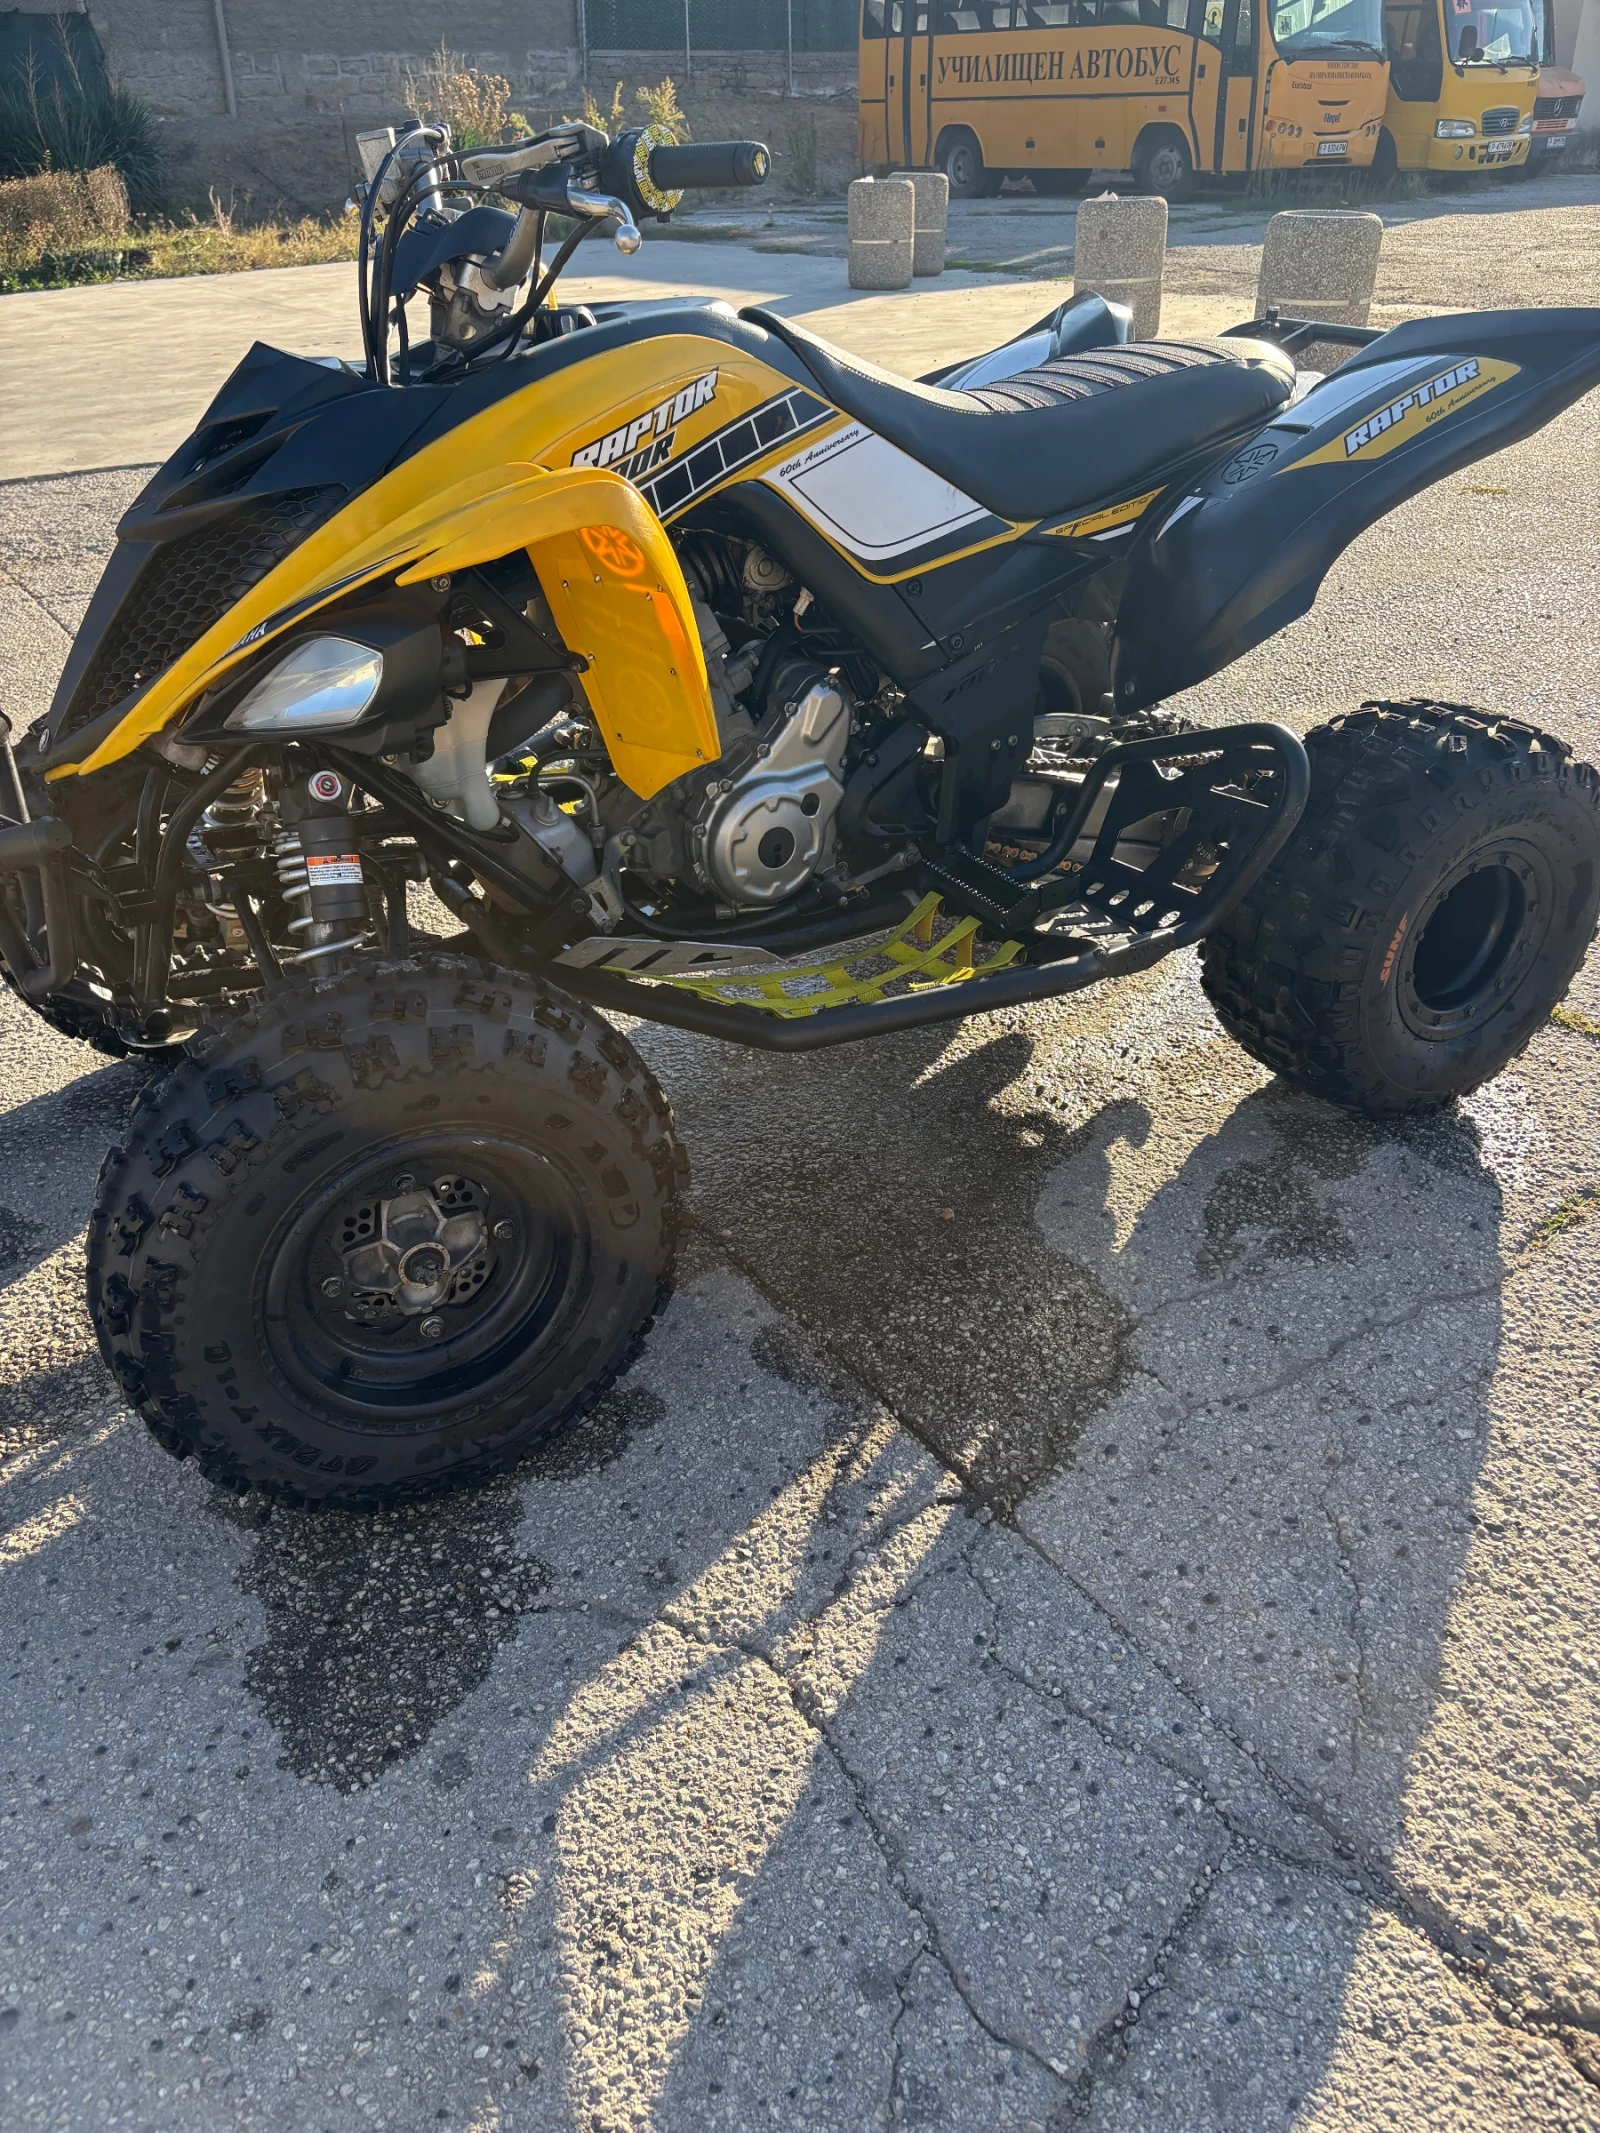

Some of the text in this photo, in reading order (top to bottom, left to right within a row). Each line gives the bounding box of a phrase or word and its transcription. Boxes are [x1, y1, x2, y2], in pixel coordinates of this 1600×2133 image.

[937, 44, 1182, 86] УЧИЛИЩЕН АВТОБУС
[1291, 81, 1312, 90] Eurobus
[569, 366, 719, 467] RAPTOR
[1343, 358, 1482, 458] RAPTOR
[1425, 374, 1497, 424] 60th Anniversary
[779, 428, 860, 478] 60th Anniversary
[1110, 492, 1156, 516] EDITION
